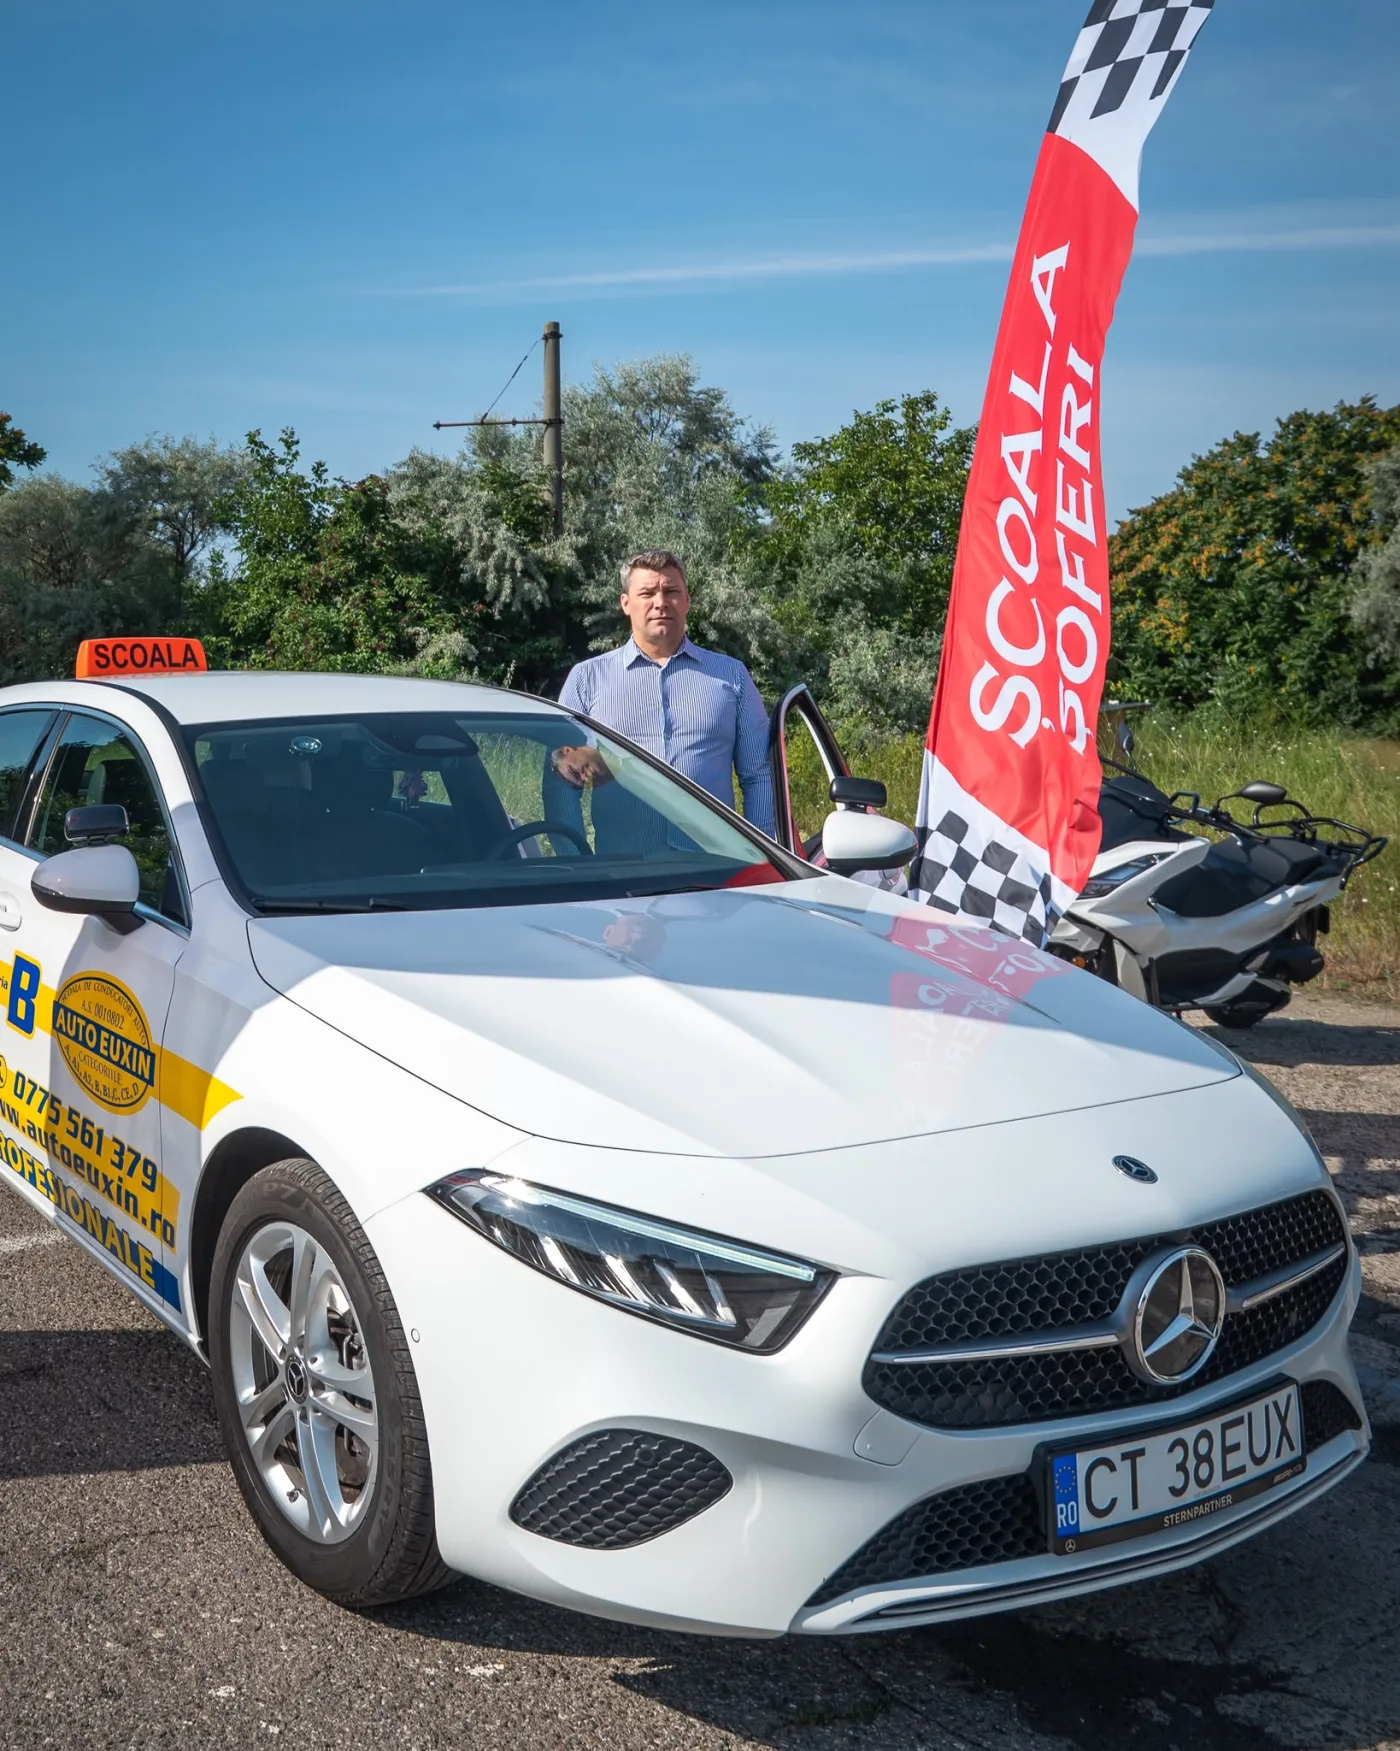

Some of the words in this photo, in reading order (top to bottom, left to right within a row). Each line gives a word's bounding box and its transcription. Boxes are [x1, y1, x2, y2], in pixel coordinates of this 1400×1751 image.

[94, 643, 199, 669] SCOALA
[8, 953, 41, 1035] B
[83, 981, 92, 991] DE
[93, 982, 133, 1017] CONDUCATORI
[132, 1018, 147, 1046] AUTO
[94, 1002, 125, 1030] 0010802
[56, 1007, 97, 1049] AUTO
[99, 1029, 151, 1080] EUXIN
[131, 1082, 139, 1096] D
[13, 1071, 62, 1126] 0775
[66, 1105, 104, 1158] 561
[110, 1136, 158, 1193] 379
[1084, 1446, 1146, 1519] CT
[1167, 1393, 1296, 1498] 38EUX
[1057, 1500, 1078, 1528] RO
[1163, 1495, 1233, 1527] STERNPARTNER
